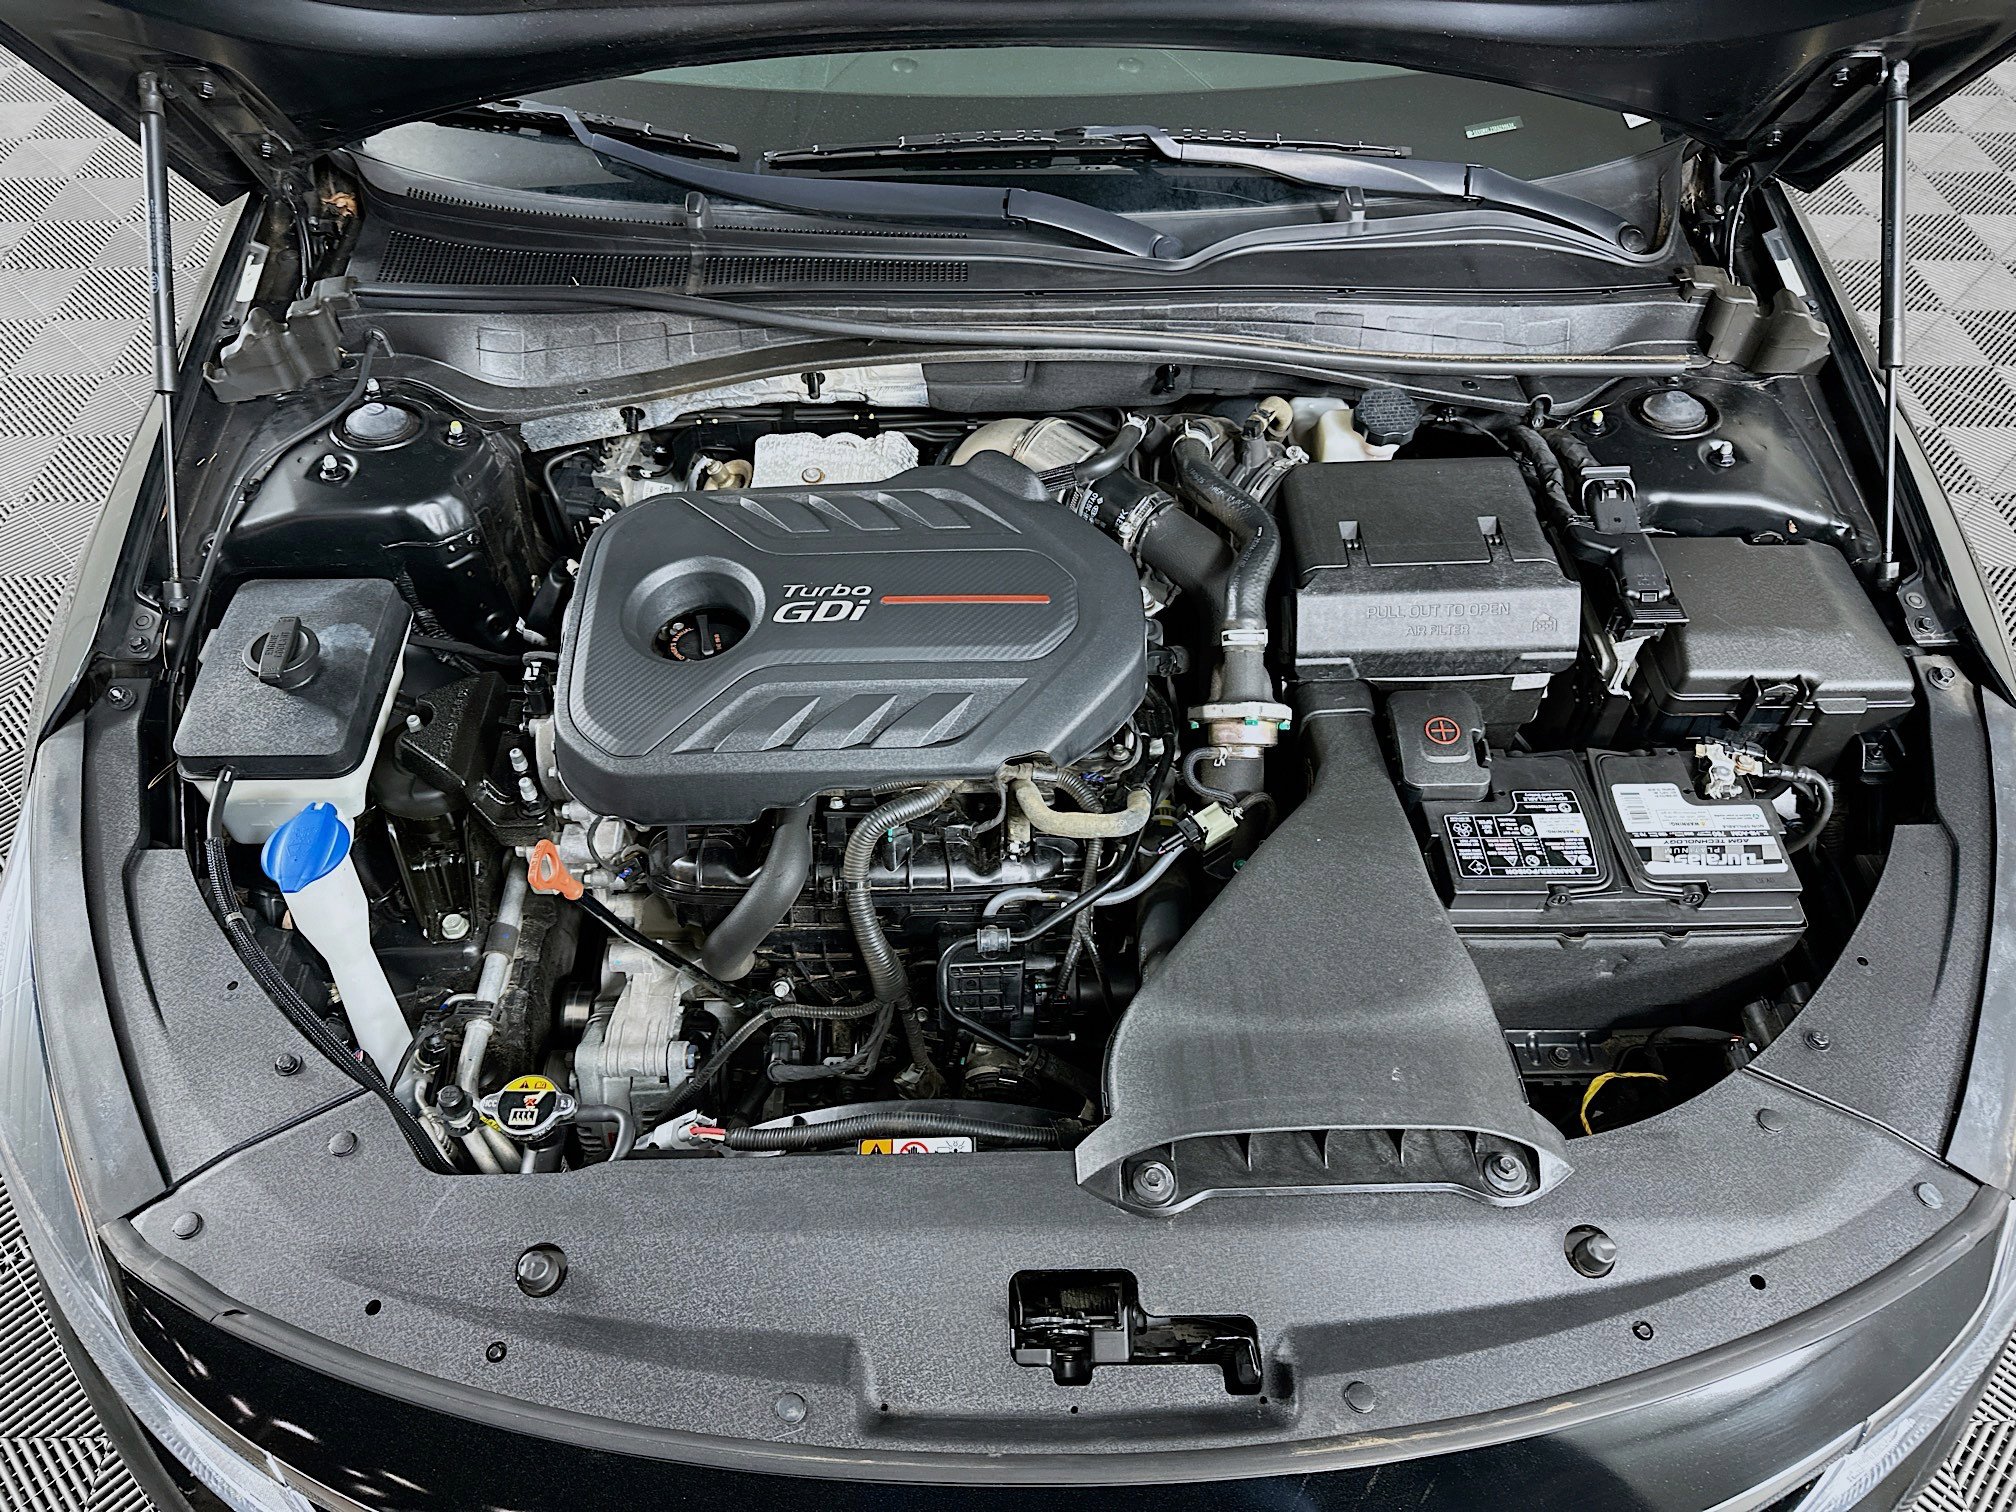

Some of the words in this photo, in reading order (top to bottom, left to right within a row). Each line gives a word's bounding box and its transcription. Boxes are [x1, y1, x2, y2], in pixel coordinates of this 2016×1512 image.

[782, 583, 873, 598] Turbo
[772, 599, 871, 623] GDi
[1366, 605, 1406, 619] PULL
[1408, 604, 1441, 618] OUT
[1445, 603, 1465, 617] TO
[1469, 602, 1511, 616] OPEN
[1405, 625, 1427, 636] AIR
[1430, 624, 1470, 636] FILTER
[273, 631, 292, 658] COOLANT
[1665, 853, 1757, 867] Duralast
